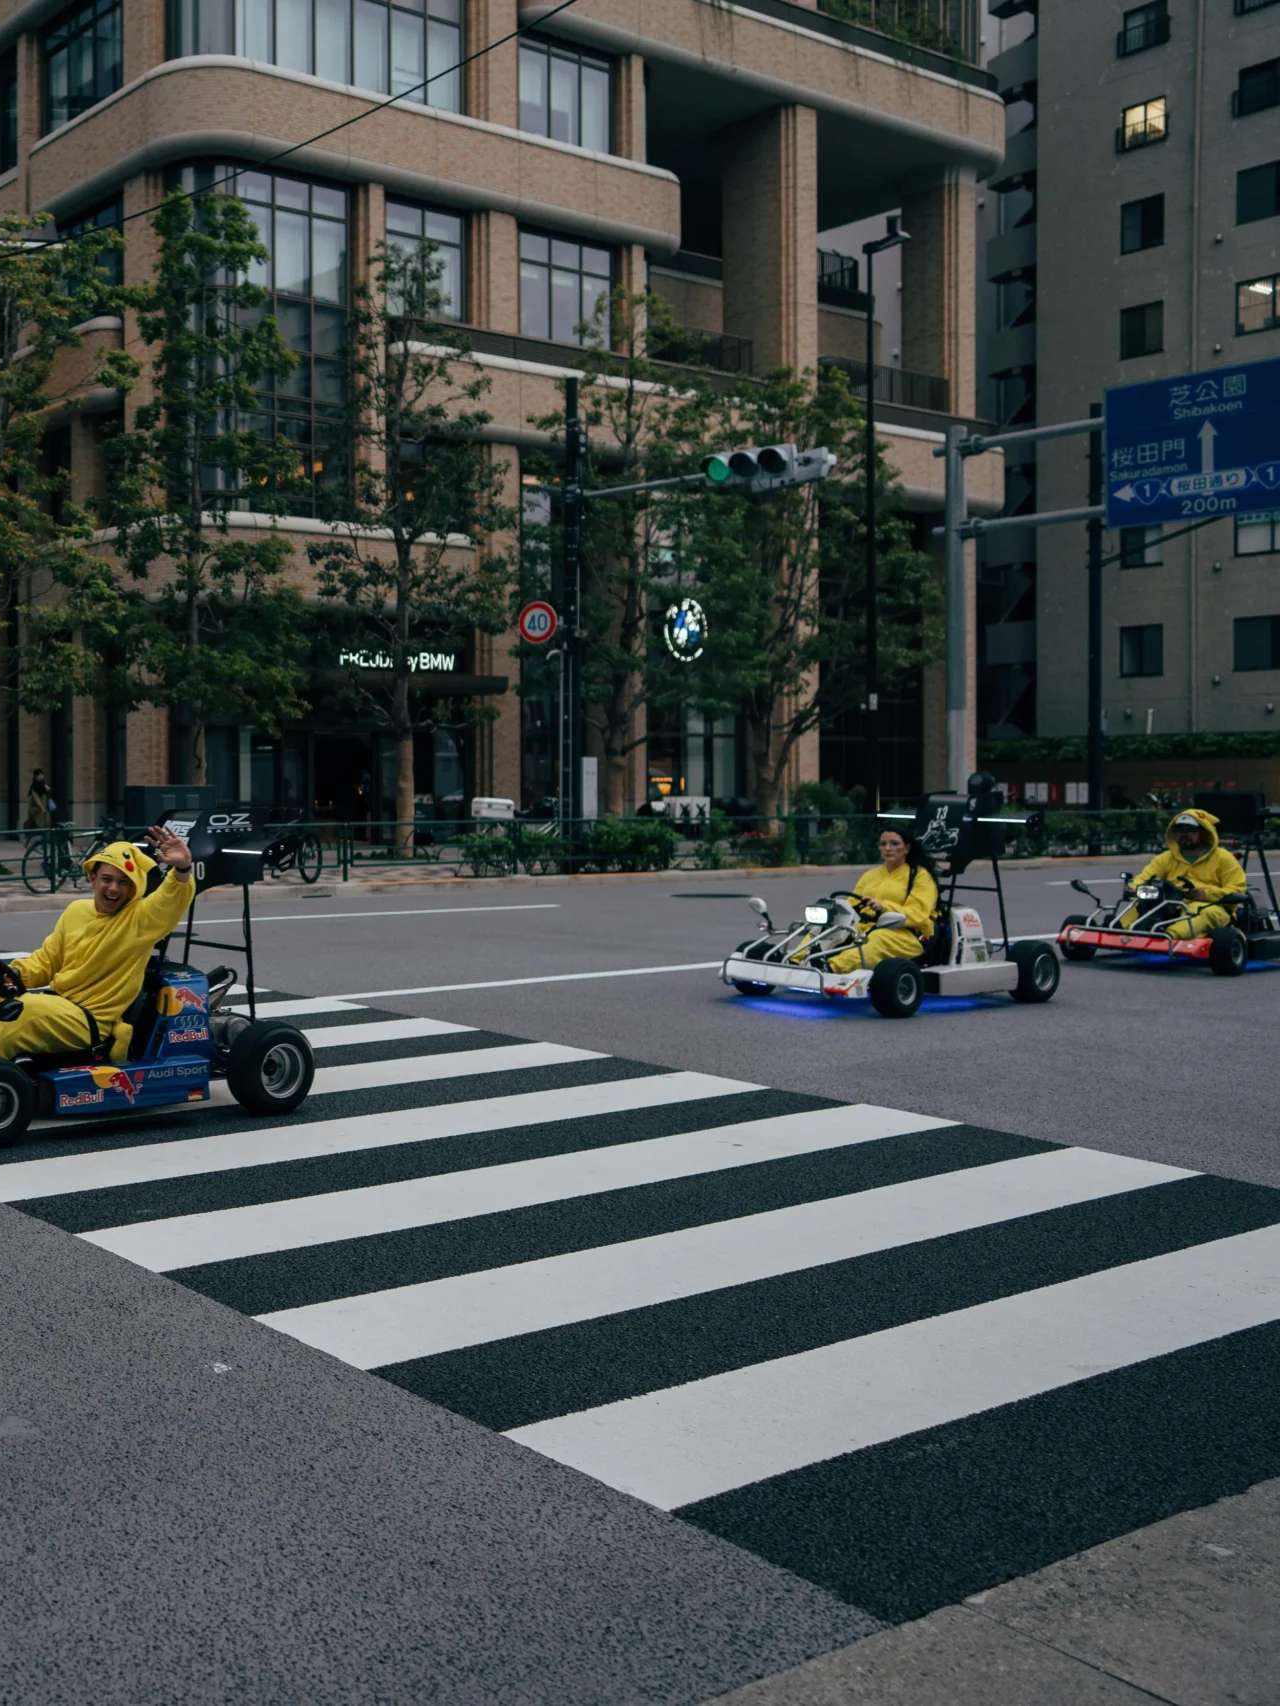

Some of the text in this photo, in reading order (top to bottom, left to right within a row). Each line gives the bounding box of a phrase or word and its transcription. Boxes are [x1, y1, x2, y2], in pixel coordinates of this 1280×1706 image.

[1169, 374, 1247, 407] 芝公園
[1173, 400, 1243, 420] Shibakoen
[1111, 438, 1185, 468] 桜田門
[1109, 462, 1188, 482] Sakuradamon
[1265, 465, 1274, 482] 1
[1143, 483, 1151, 498] 1
[1176, 472, 1240, 493] 桜田通り
[1181, 496, 1237, 515] 200m
[527, 613, 548, 631] 40
[419, 652, 455, 671] BMW
[935, 804, 949, 820] 13
[147, 1064, 208, 1079] Audi Sport
